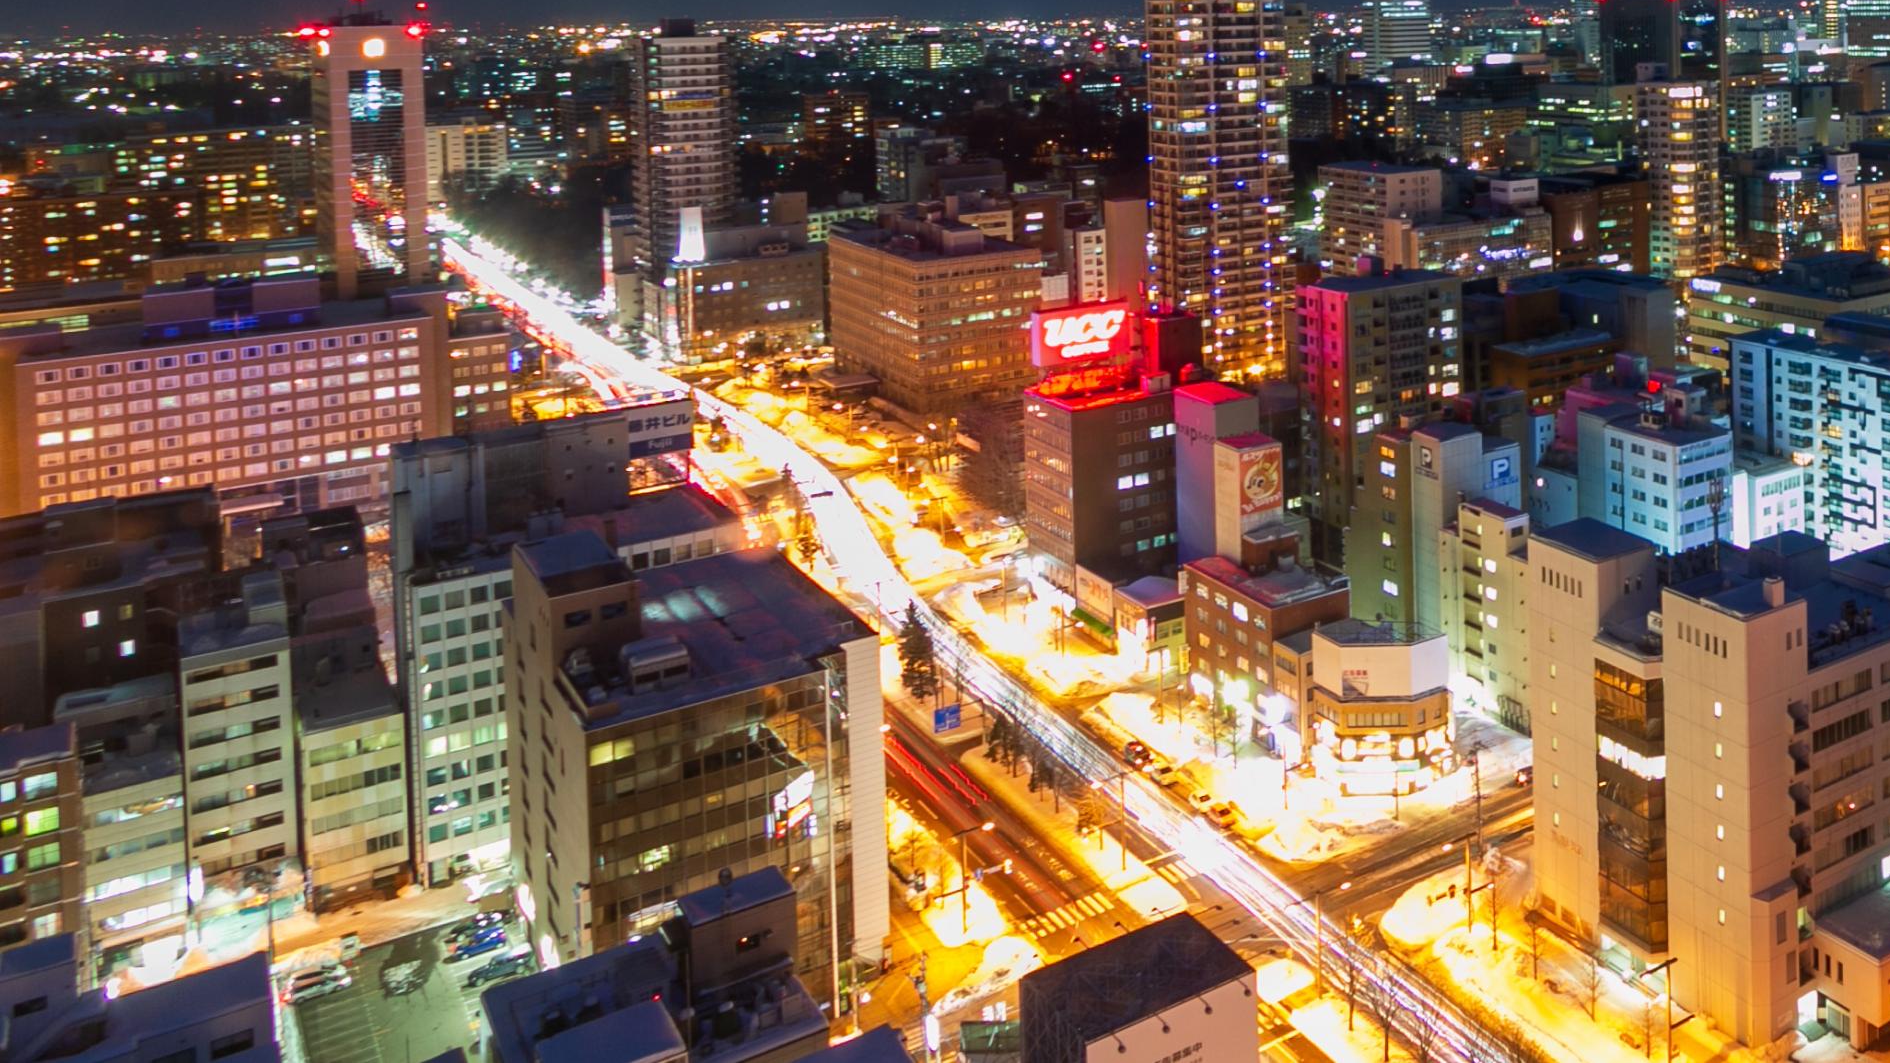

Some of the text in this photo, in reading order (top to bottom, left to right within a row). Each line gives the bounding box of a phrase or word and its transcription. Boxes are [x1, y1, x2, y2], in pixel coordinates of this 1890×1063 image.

[1043, 310, 1125, 347] UCC
[1421, 448, 1432, 466] P
[1492, 458, 1509, 479] P
